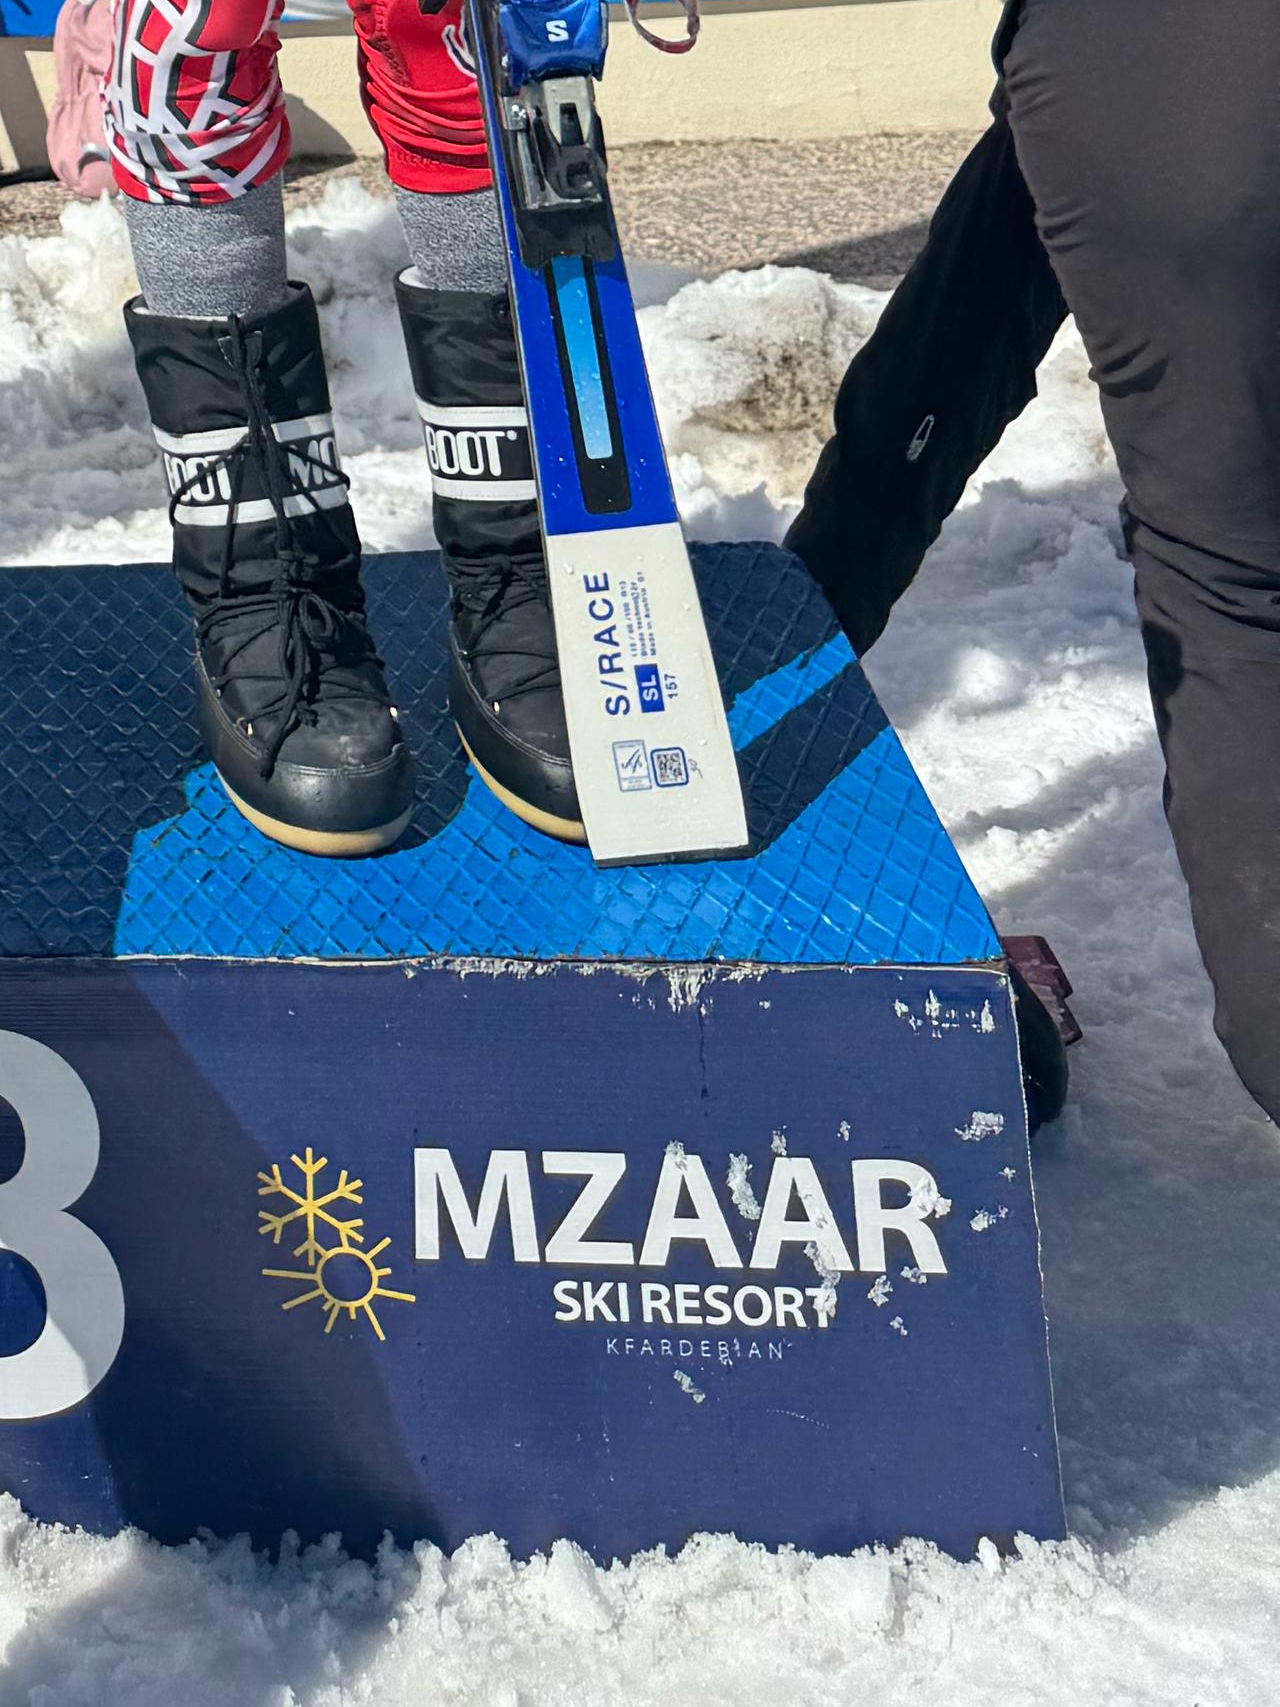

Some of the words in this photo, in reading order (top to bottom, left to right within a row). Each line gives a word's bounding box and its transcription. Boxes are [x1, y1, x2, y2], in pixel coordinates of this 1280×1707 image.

[583, 571, 631, 716] S/RACE
[642, 674, 659, 702] SL
[664, 673, 679, 700] 157
[414, 1147, 949, 1275] MZAAR
[554, 1280, 629, 1326] SKI
[642, 1282, 835, 1331] RESORT
[605, 1337, 789, 1362] KFARDEBIAN
